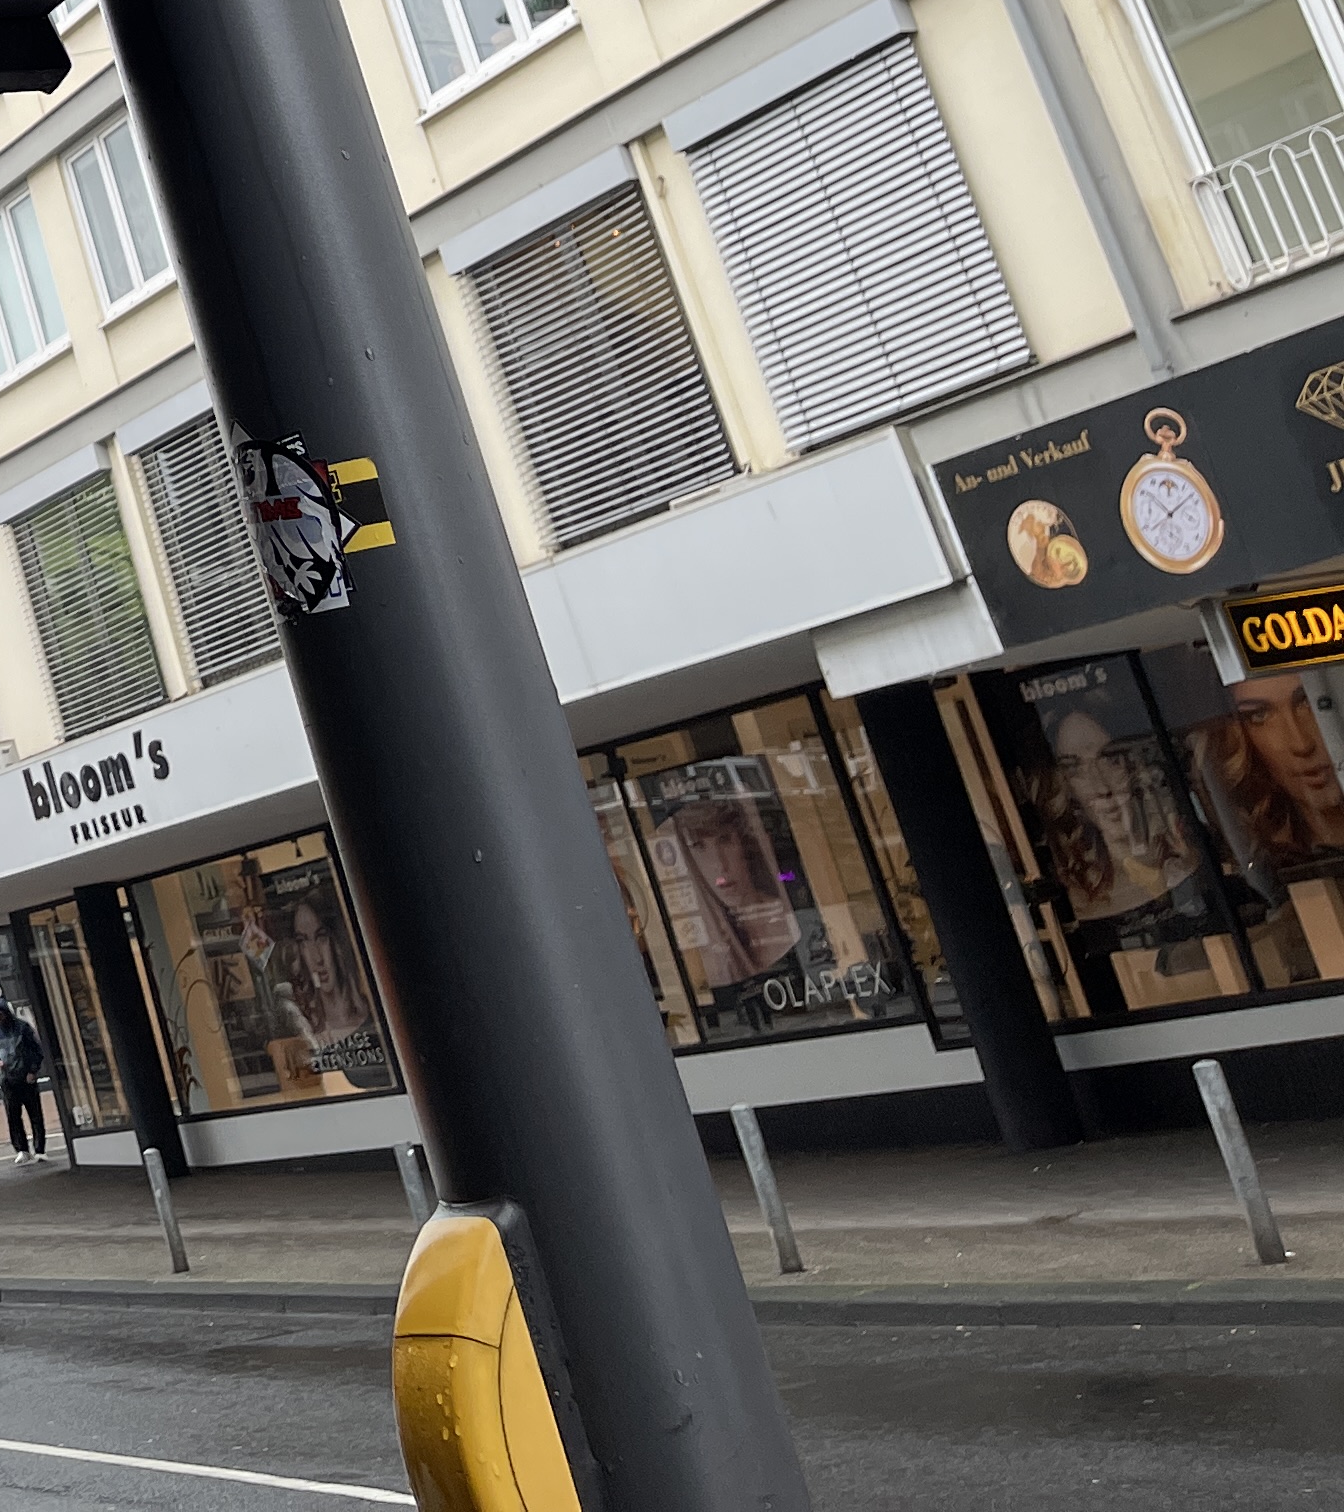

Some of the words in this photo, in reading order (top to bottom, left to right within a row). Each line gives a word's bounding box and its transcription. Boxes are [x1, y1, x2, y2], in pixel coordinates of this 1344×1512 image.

[986, 455, 1019, 484] und
[1019, 429, 1092, 470] Verkauf
[1019, 664, 1107, 703] bloom's
[22, 729, 169, 821] bloom's
[70, 804, 147, 844] FRISEUR
[764, 960, 892, 1011] OLAPLEX
